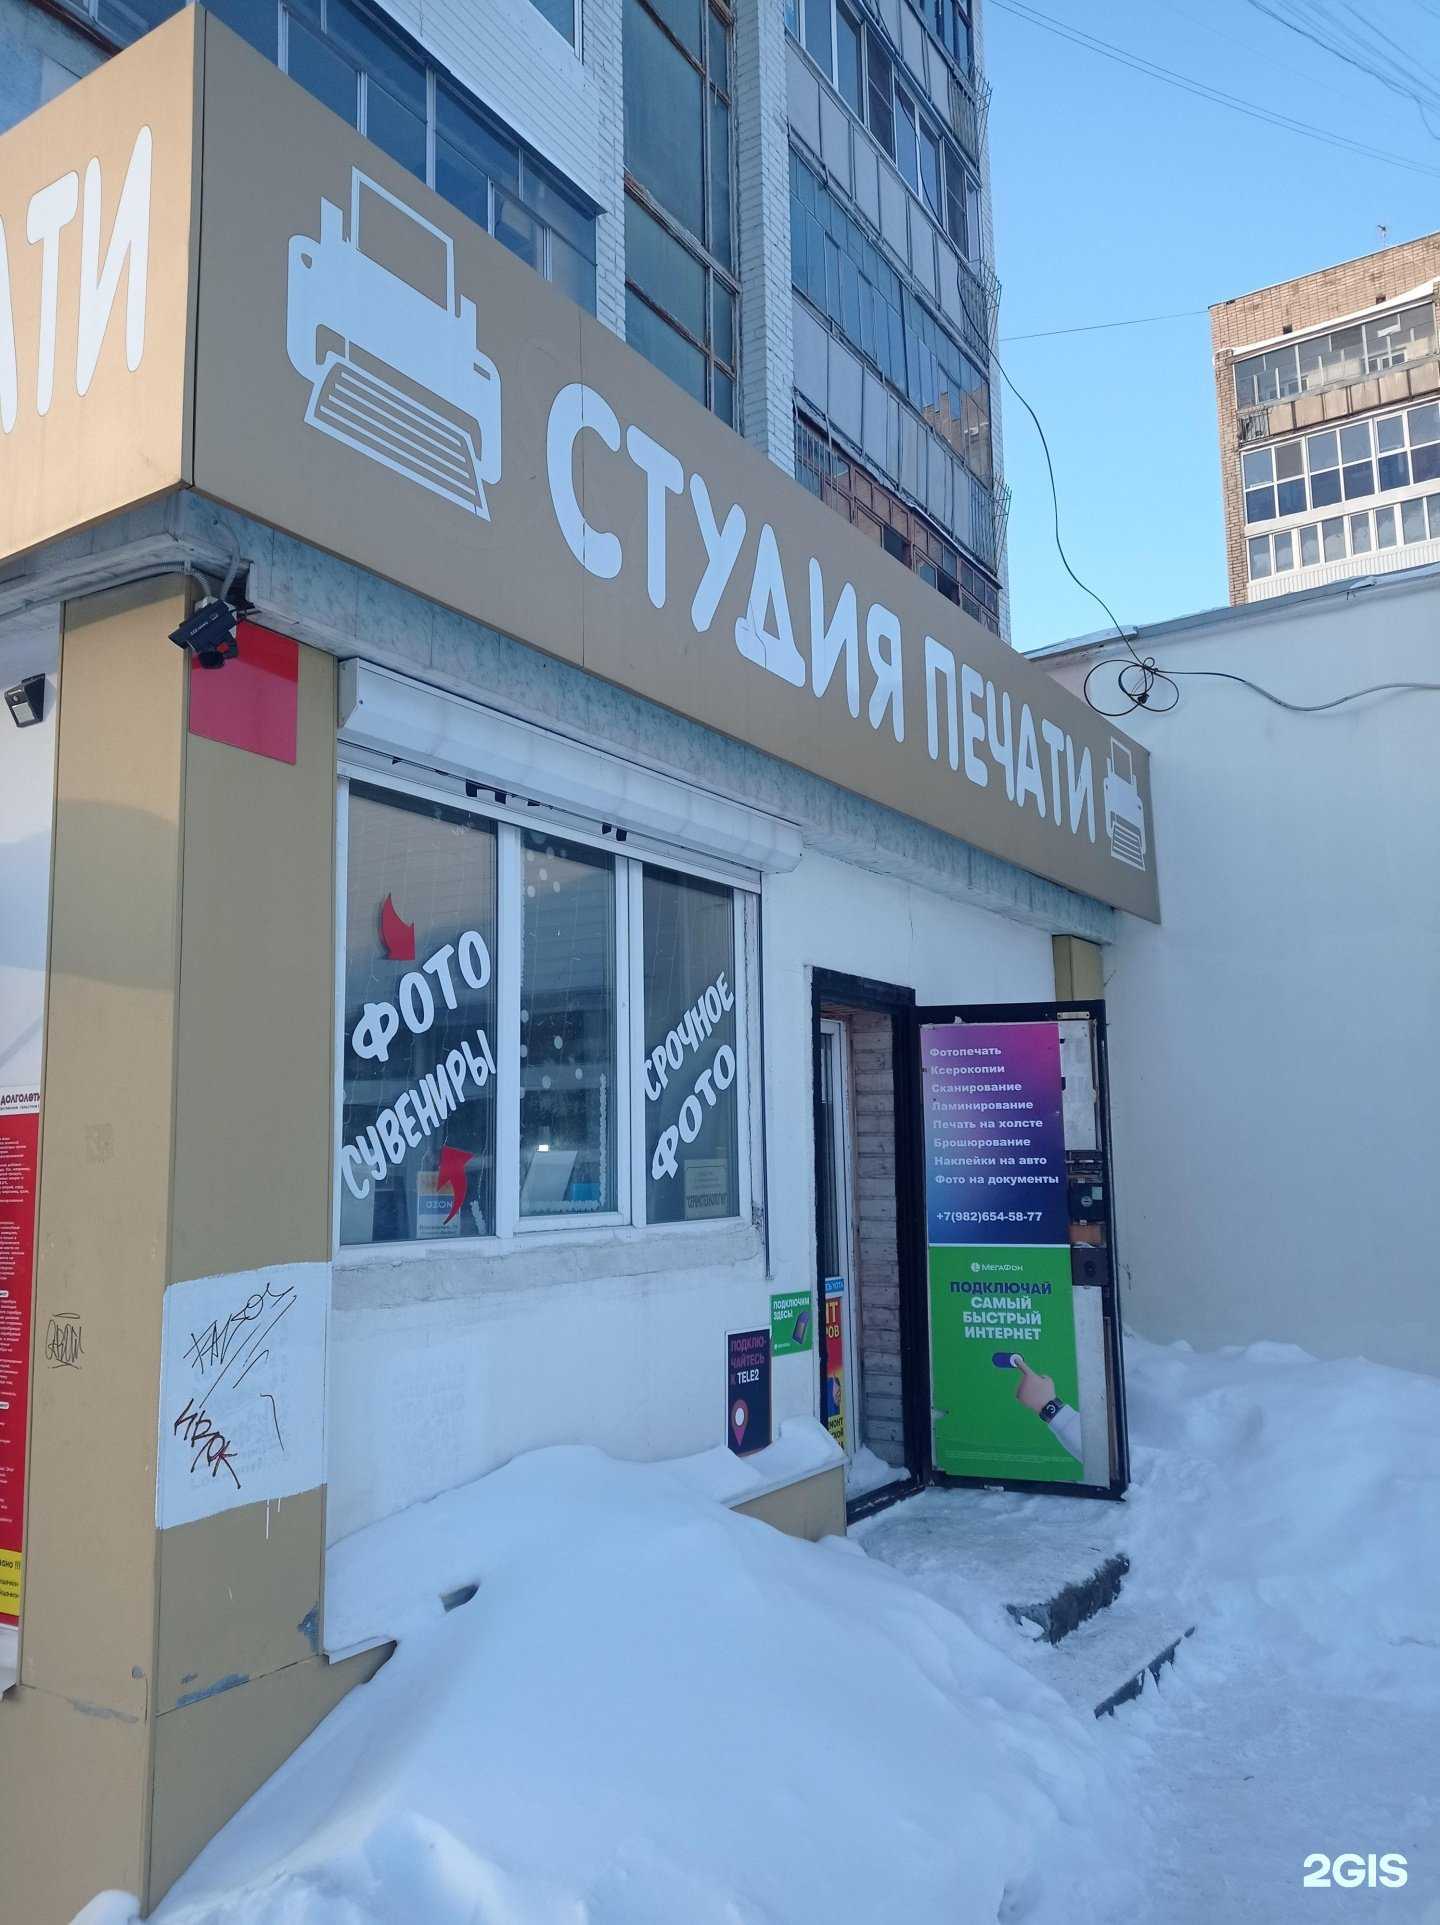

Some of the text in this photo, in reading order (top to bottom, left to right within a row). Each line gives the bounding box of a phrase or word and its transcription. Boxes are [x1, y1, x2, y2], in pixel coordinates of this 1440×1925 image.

[0, 125, 153, 434] ТИ
[546, 383, 1096, 843] СТУДИЯ ПЕЧАТИ
[352, 930, 491, 1062] ФОТО
[644, 972, 735, 1101] СРОЧНОЕ
[929, 1047, 1002, 1057] Фотопечать
[931, 1064, 1005, 1076] Ксерокопии
[931, 1082, 1022, 1095] Сканирование
[651, 1044, 736, 1181] ФОТО
[932, 1101, 1034, 1112] Ламинирование
[341, 1029, 497, 1199] СУВЕНИРЫ
[933, 1119, 1043, 1129] Печать на холсте
[934, 1137, 1031, 1149] Брошюрование
[934, 1155, 1047, 1166] Наклейки на авто
[935, 1174, 1060, 1186] Фото на документы
[936, 1211, 1043, 1223] +7(982)654-58-77
[950, 1281, 1052, 1295] ПОДКЛЮЧАЙ
[971, 1296, 1032, 1310] САМЫЙ
[963, 1310, 1042, 1326] БЫСТРЫЙ
[964, 1326, 1042, 1341] ИНТЕРНЕТ
[736, 1368, 760, 1385] TELE2
